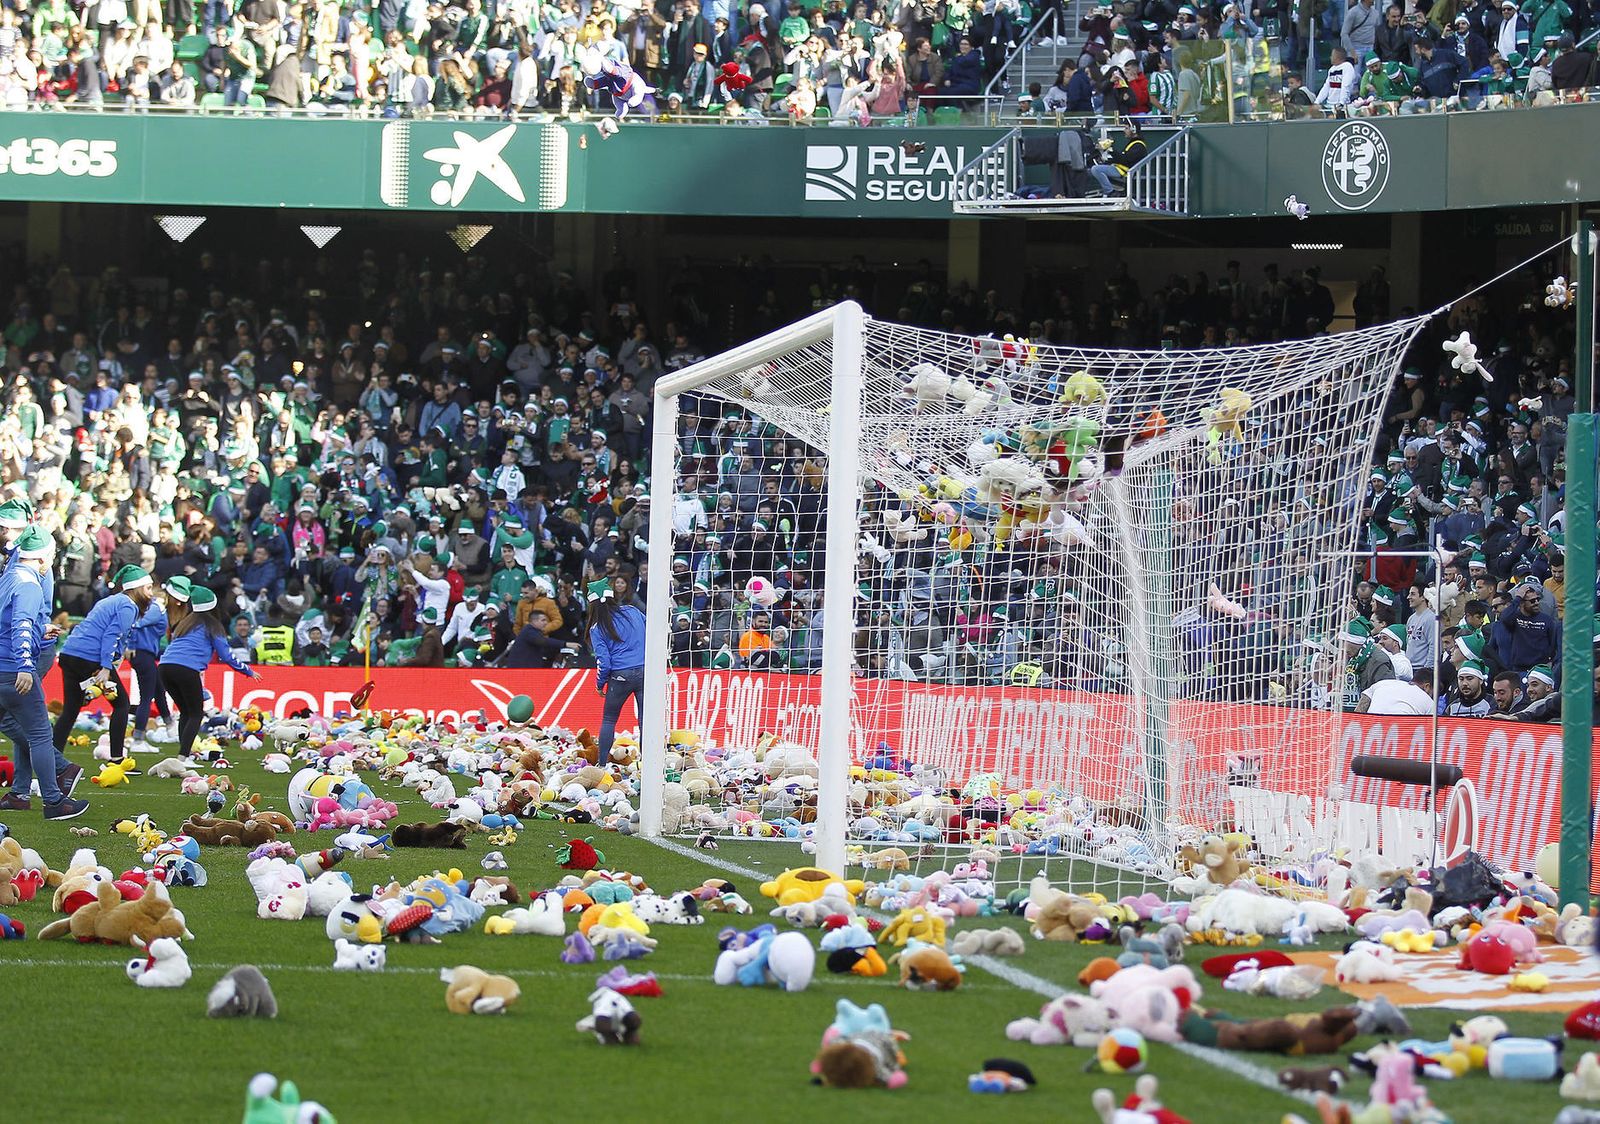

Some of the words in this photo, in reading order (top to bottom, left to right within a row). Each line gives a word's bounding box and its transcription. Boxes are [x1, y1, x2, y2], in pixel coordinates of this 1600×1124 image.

[867, 146, 1006, 176] REALE
[1325, 131, 1348, 167] ALFA
[1352, 125, 1387, 165] ROMEO
[865, 180, 1006, 201] SEGUROS
